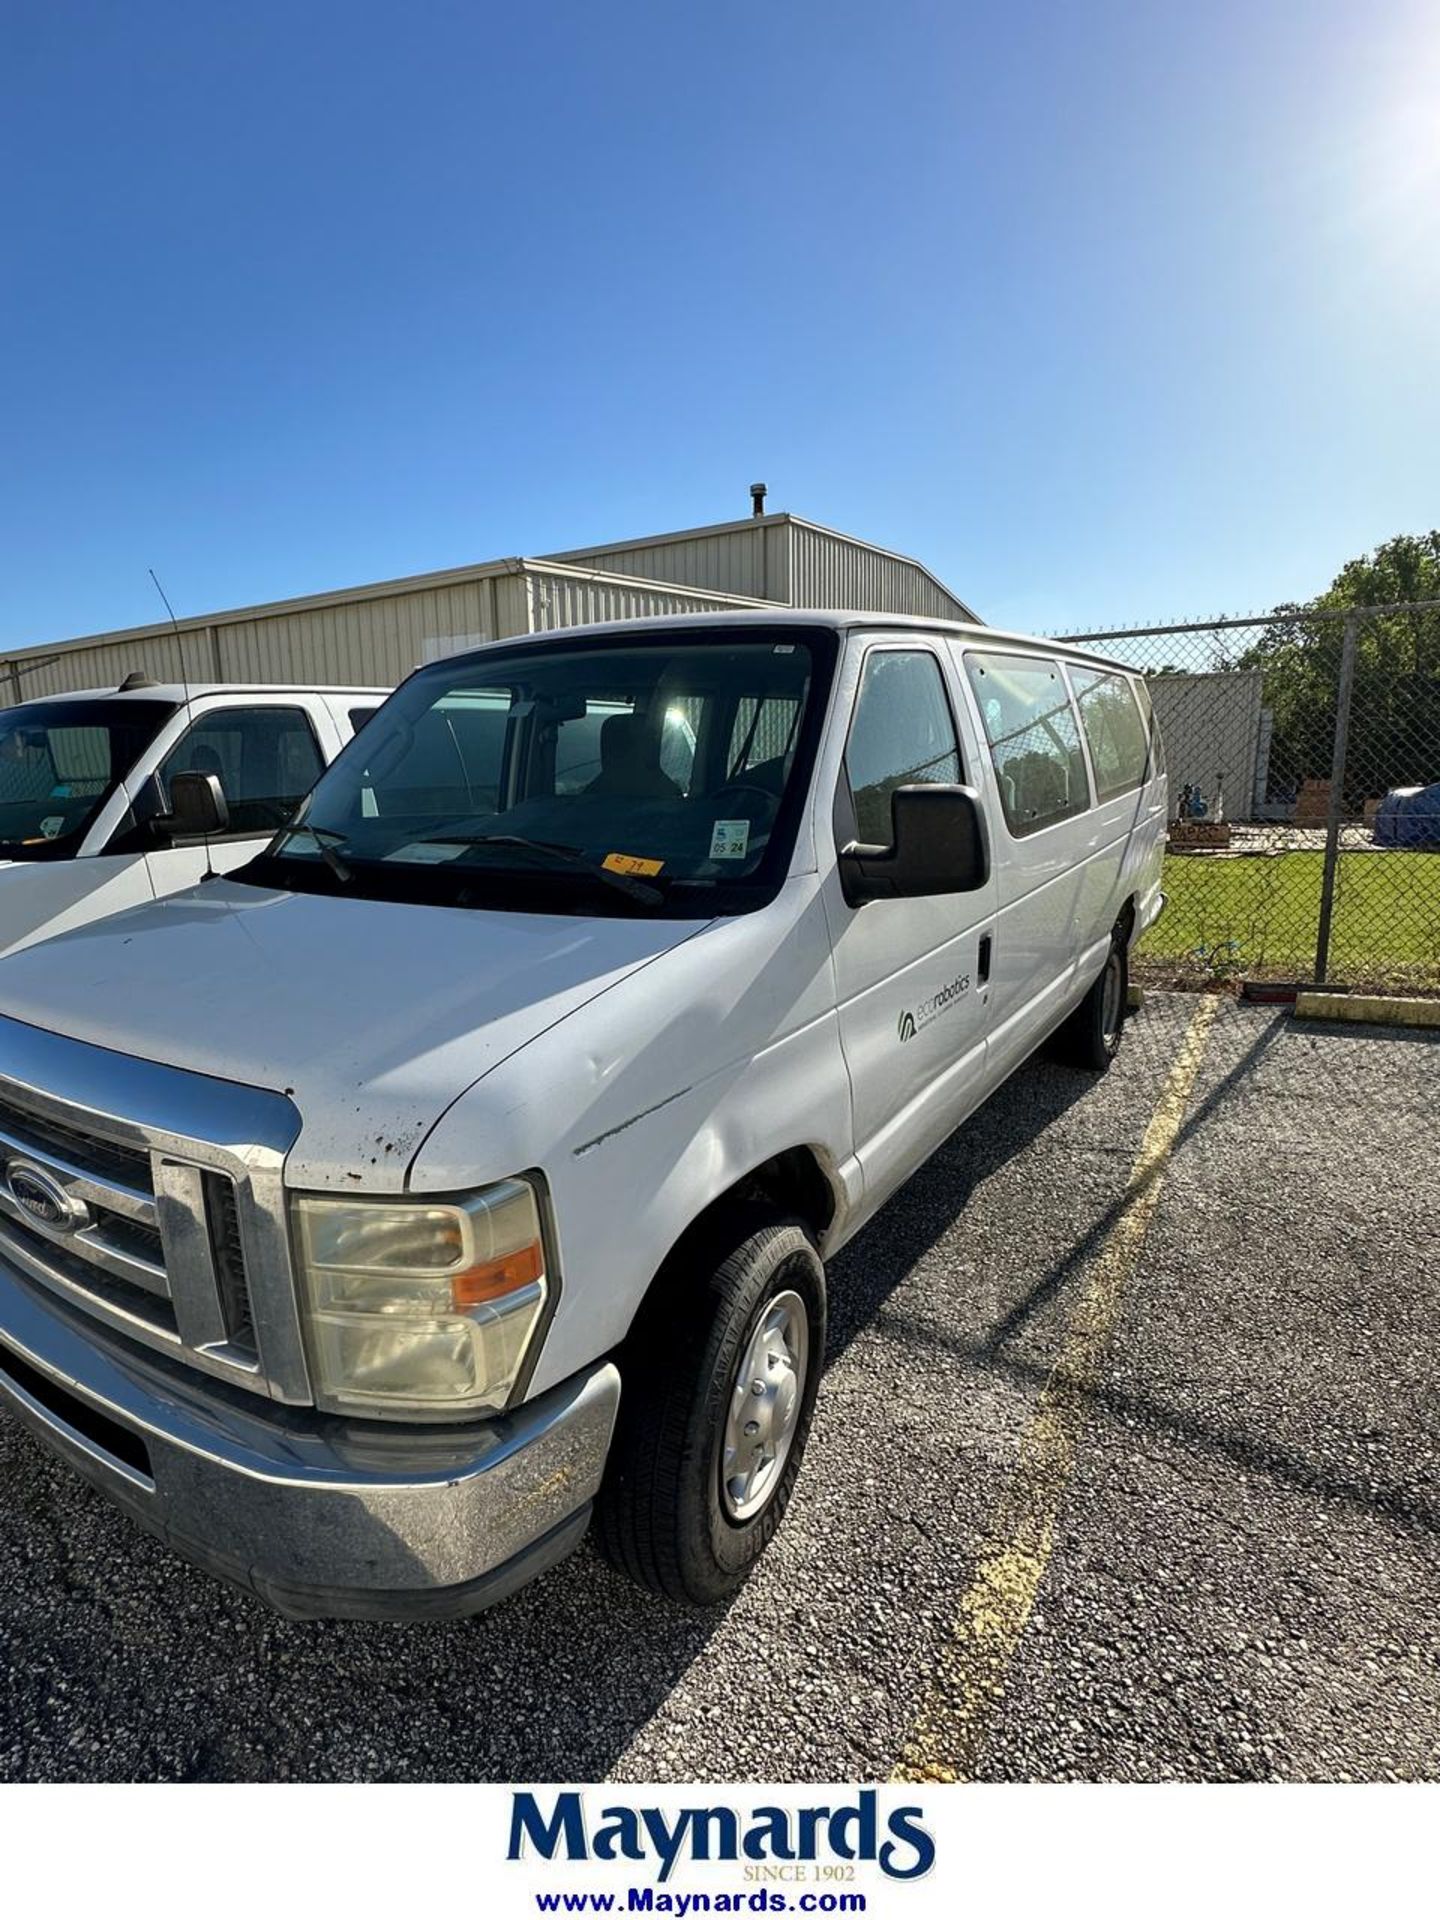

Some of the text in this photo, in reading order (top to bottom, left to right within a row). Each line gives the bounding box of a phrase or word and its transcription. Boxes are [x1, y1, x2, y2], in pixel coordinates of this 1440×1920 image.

[713, 842, 744, 853] 05 24
[918, 974, 970, 1021] ecorobotics
